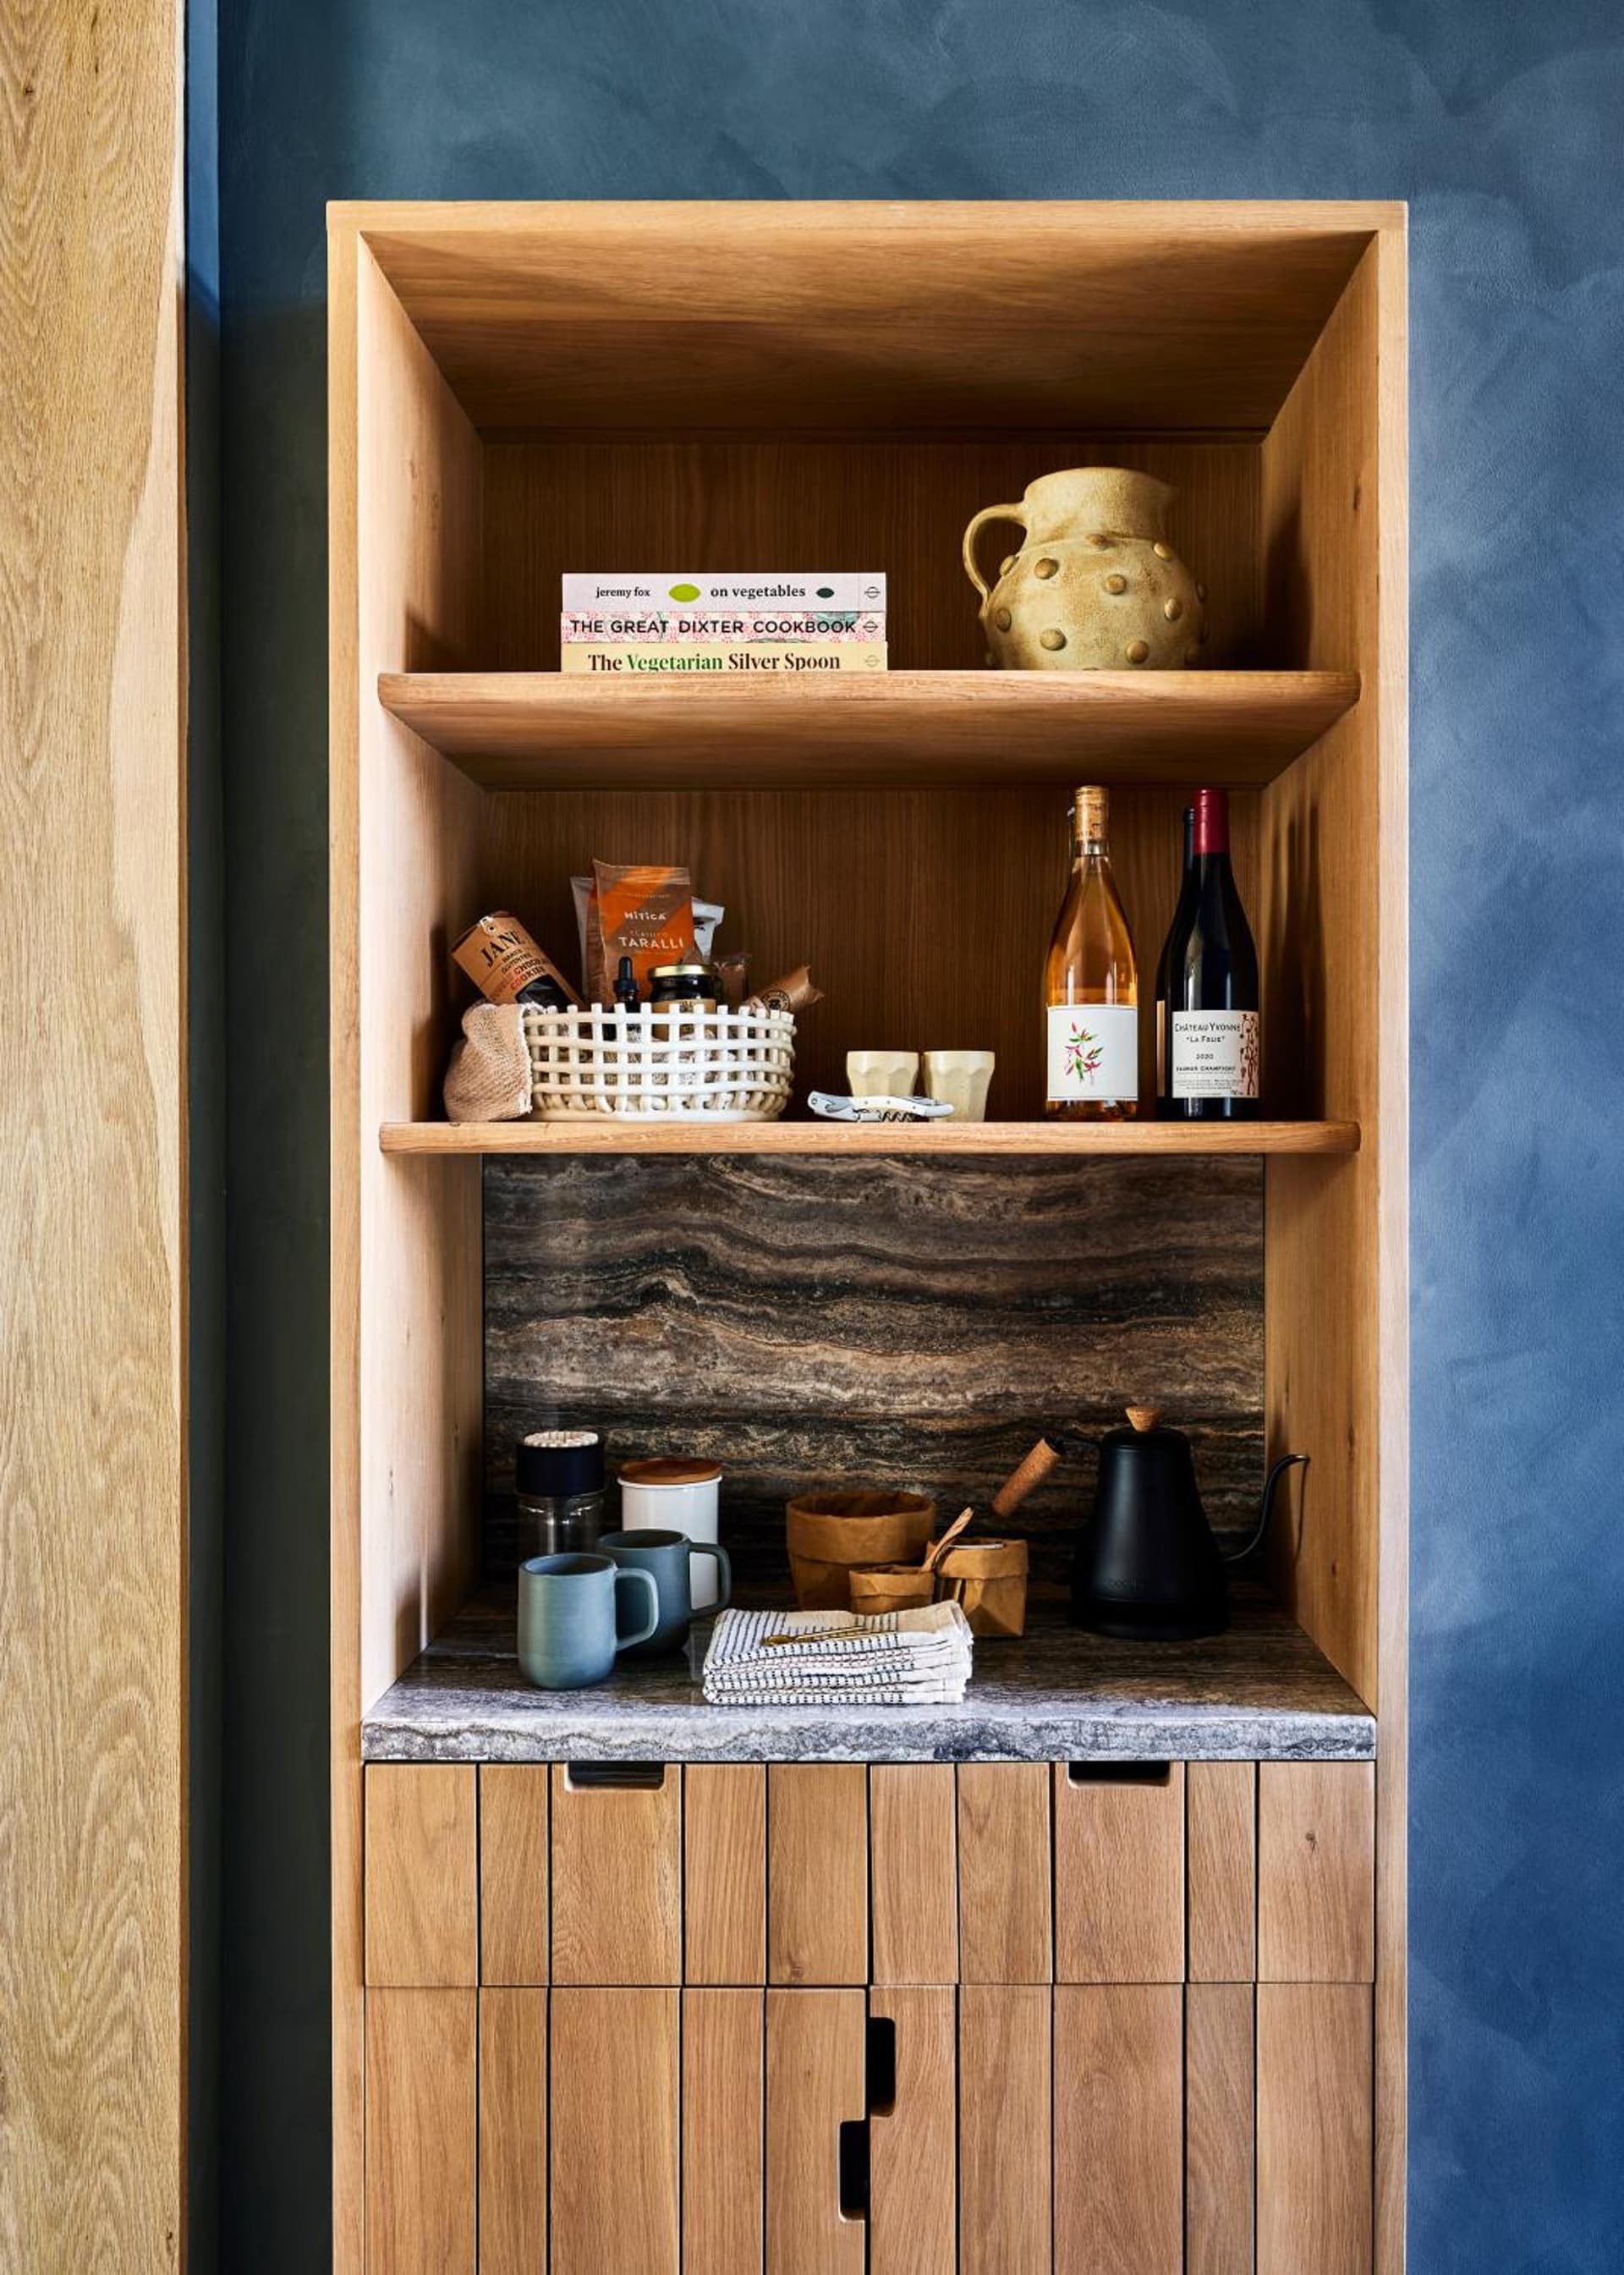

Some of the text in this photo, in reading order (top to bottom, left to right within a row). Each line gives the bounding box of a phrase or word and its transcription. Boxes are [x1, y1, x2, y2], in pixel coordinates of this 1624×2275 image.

[595, 586, 650, 598] jeremy fox
[710, 585, 806, 599] on vegetables
[570, 620, 856, 633] THE GREAT DIXTER COOKBOOK
[588, 652, 840, 672] The Vegetarian Silver Spoon
[617, 937, 684, 948] TARALLI
[1210, 1021, 1240, 1031] YVONNE
